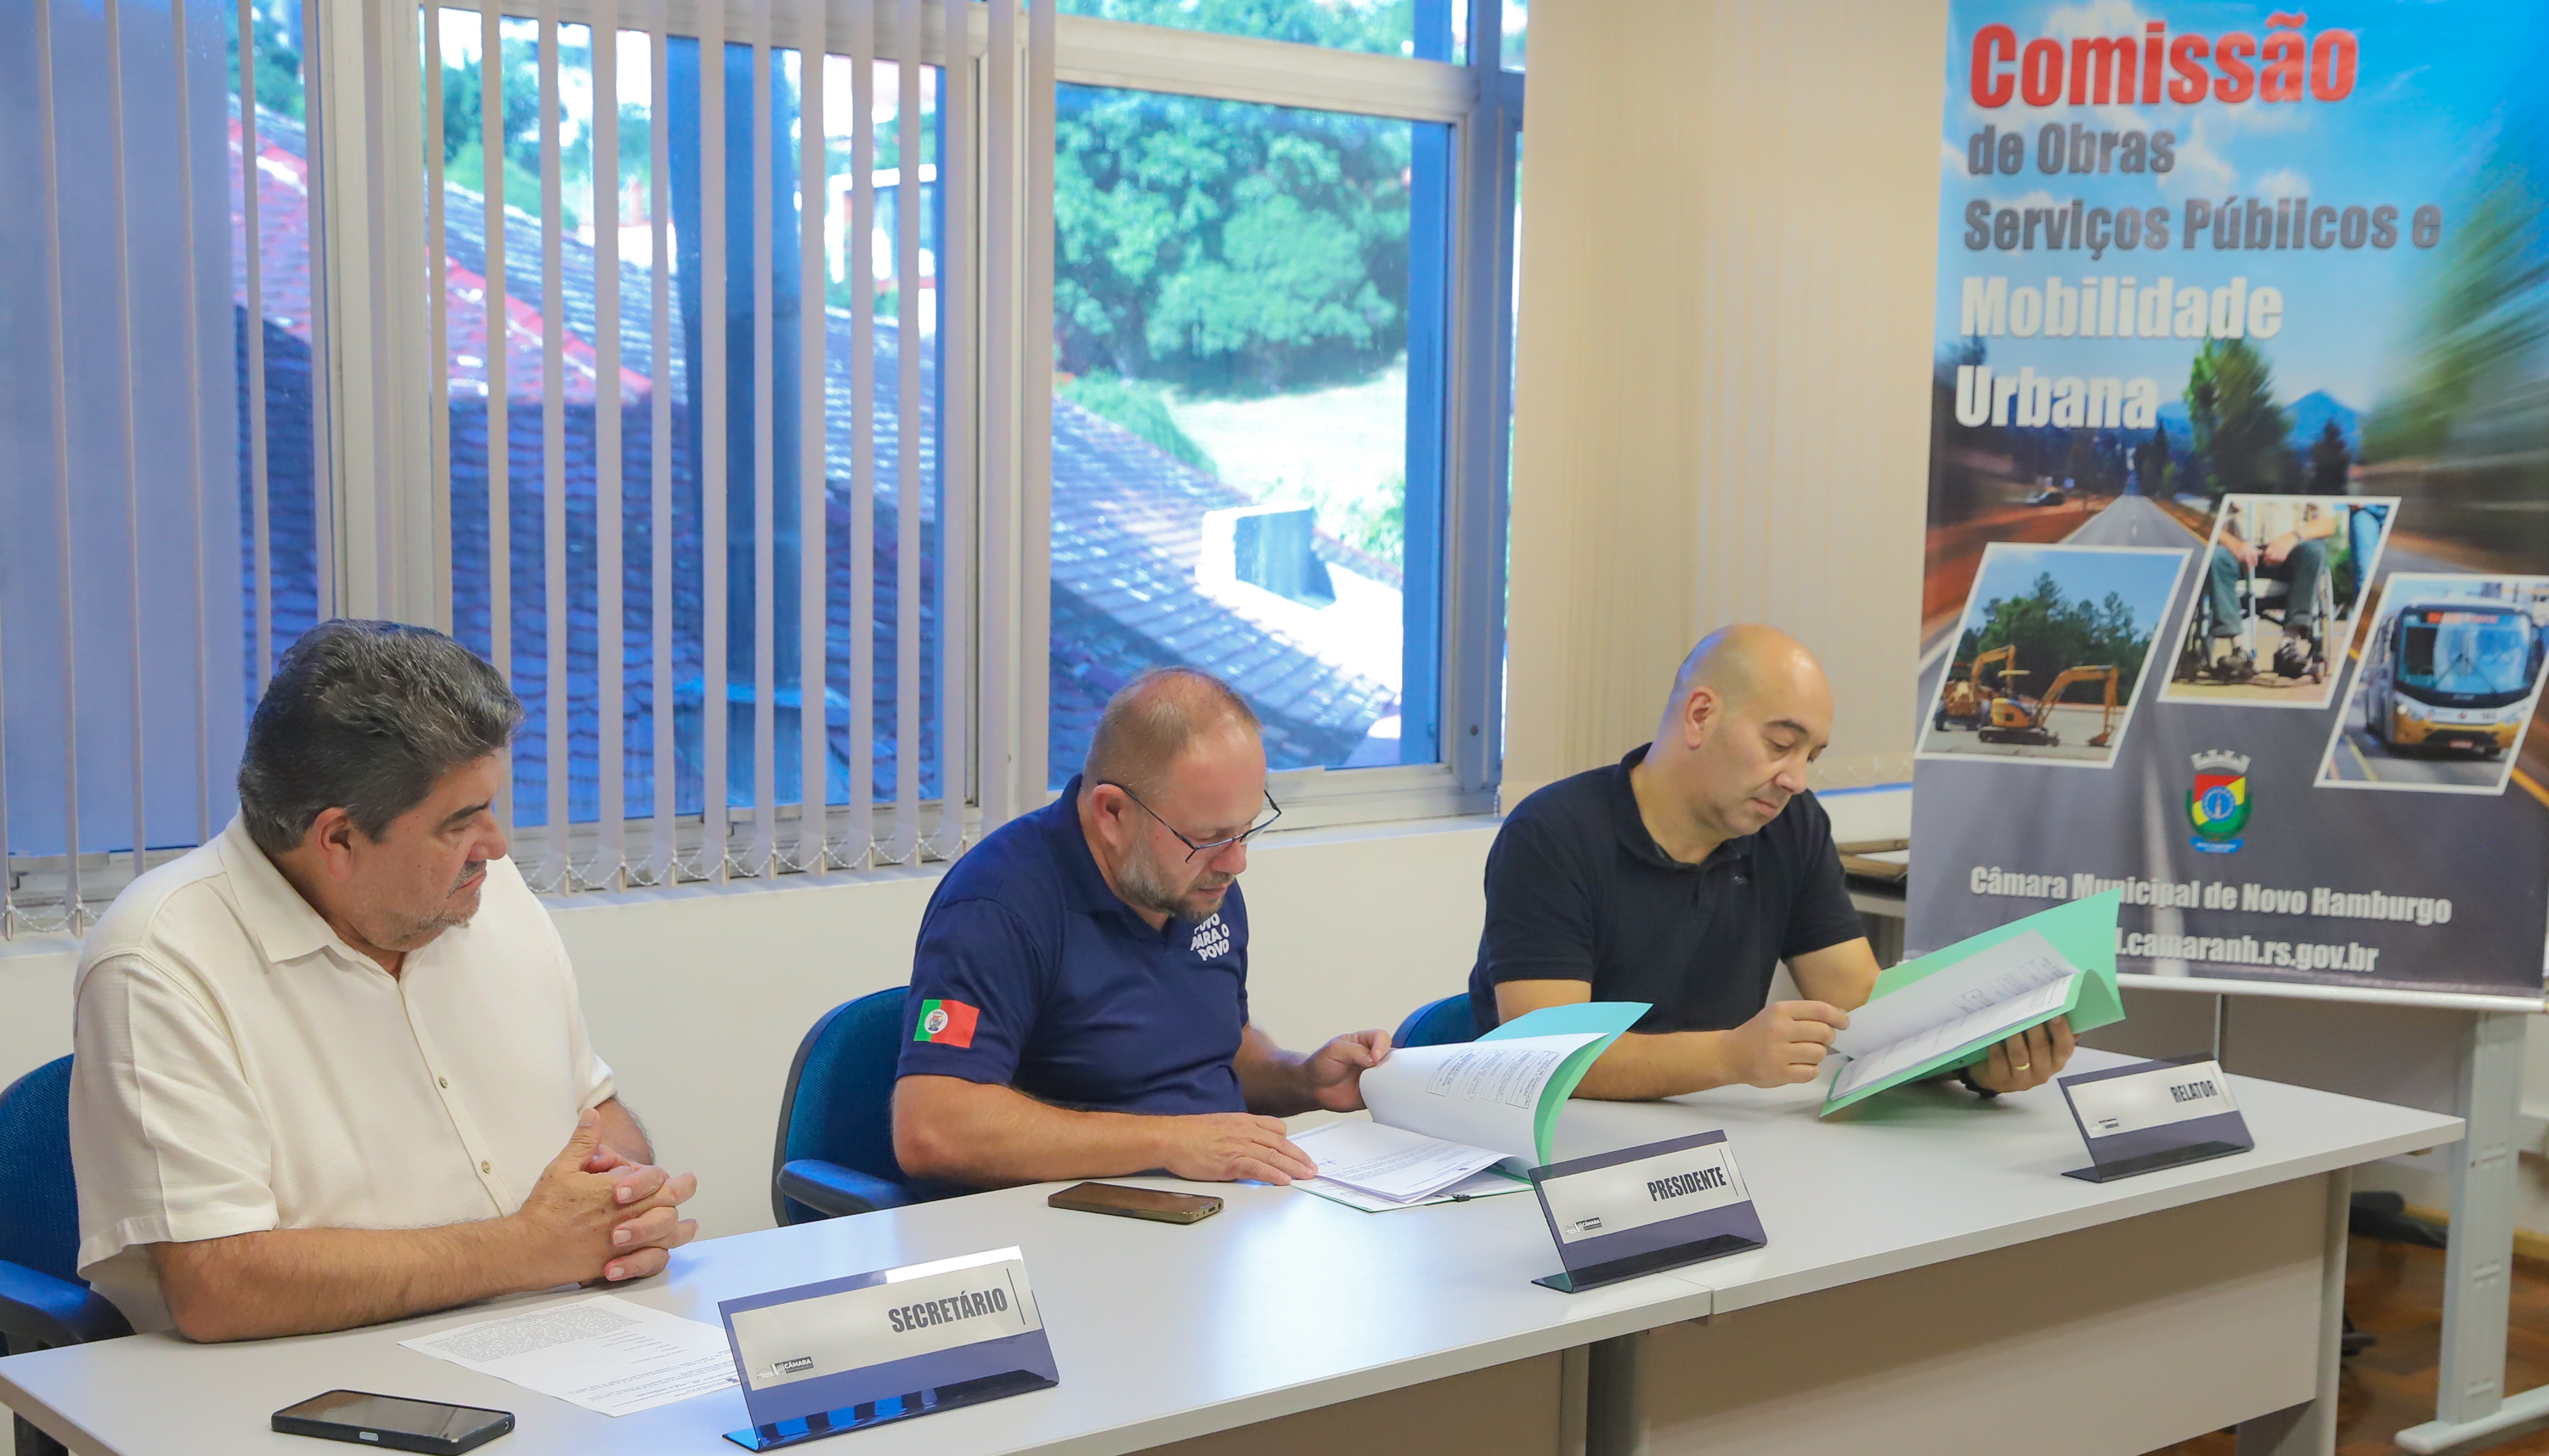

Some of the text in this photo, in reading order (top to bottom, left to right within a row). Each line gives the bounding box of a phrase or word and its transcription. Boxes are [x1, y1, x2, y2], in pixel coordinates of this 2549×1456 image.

[1970, 12, 2358, 108] Comissão
[1968, 122, 2176, 175] de Obras
[1964, 196, 2441, 260] Serviços Públicos e
[1960, 277, 2283, 340] Mobilidade
[1955, 364, 2158, 429] Urbana
[1970, 866, 2452, 926] Câmara Municipal de Novo Hamburgo
[1190, 923, 1229, 951] PARA O
[1197, 939, 1229, 961] POVO
[2170, 1081, 2218, 1103] RELATOR
[1647, 1166, 1727, 1201] PRESIDENTE
[888, 1288, 1008, 1333] SECRETÁRIO
[784, 1359, 811, 1369] CÂMARA
